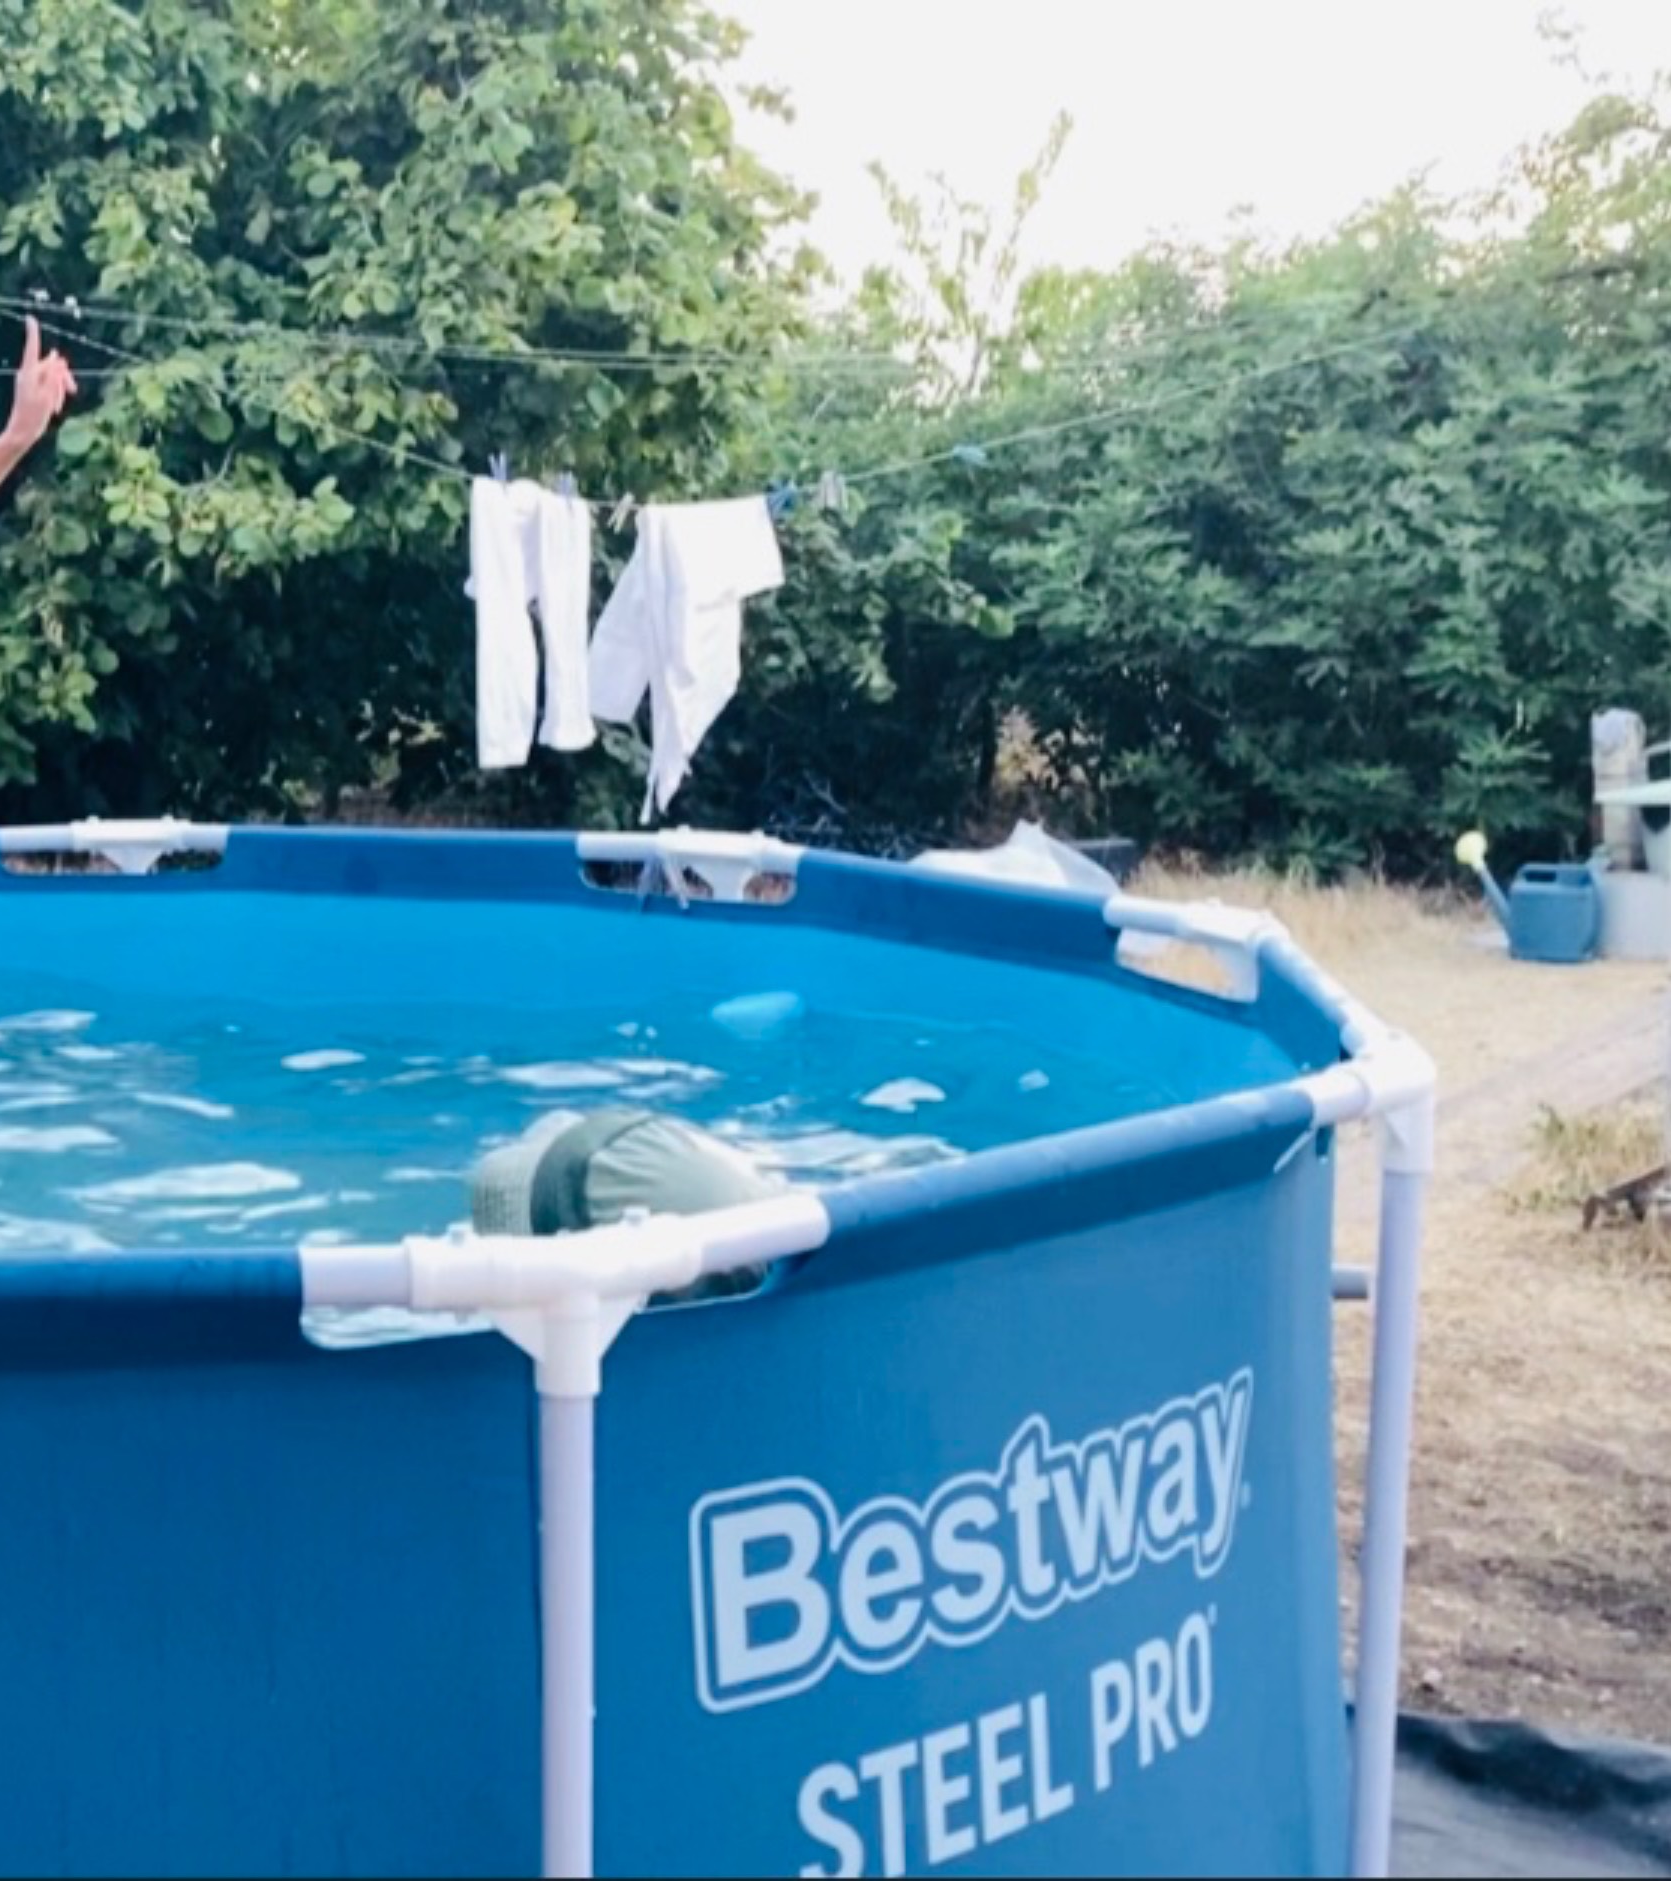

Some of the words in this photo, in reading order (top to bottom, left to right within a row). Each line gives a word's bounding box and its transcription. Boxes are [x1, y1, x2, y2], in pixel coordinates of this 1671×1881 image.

[691, 1368, 1252, 1712] Bestway
[796, 1692, 1074, 1878] STEEL
[1090, 1611, 1212, 1793] PRO
